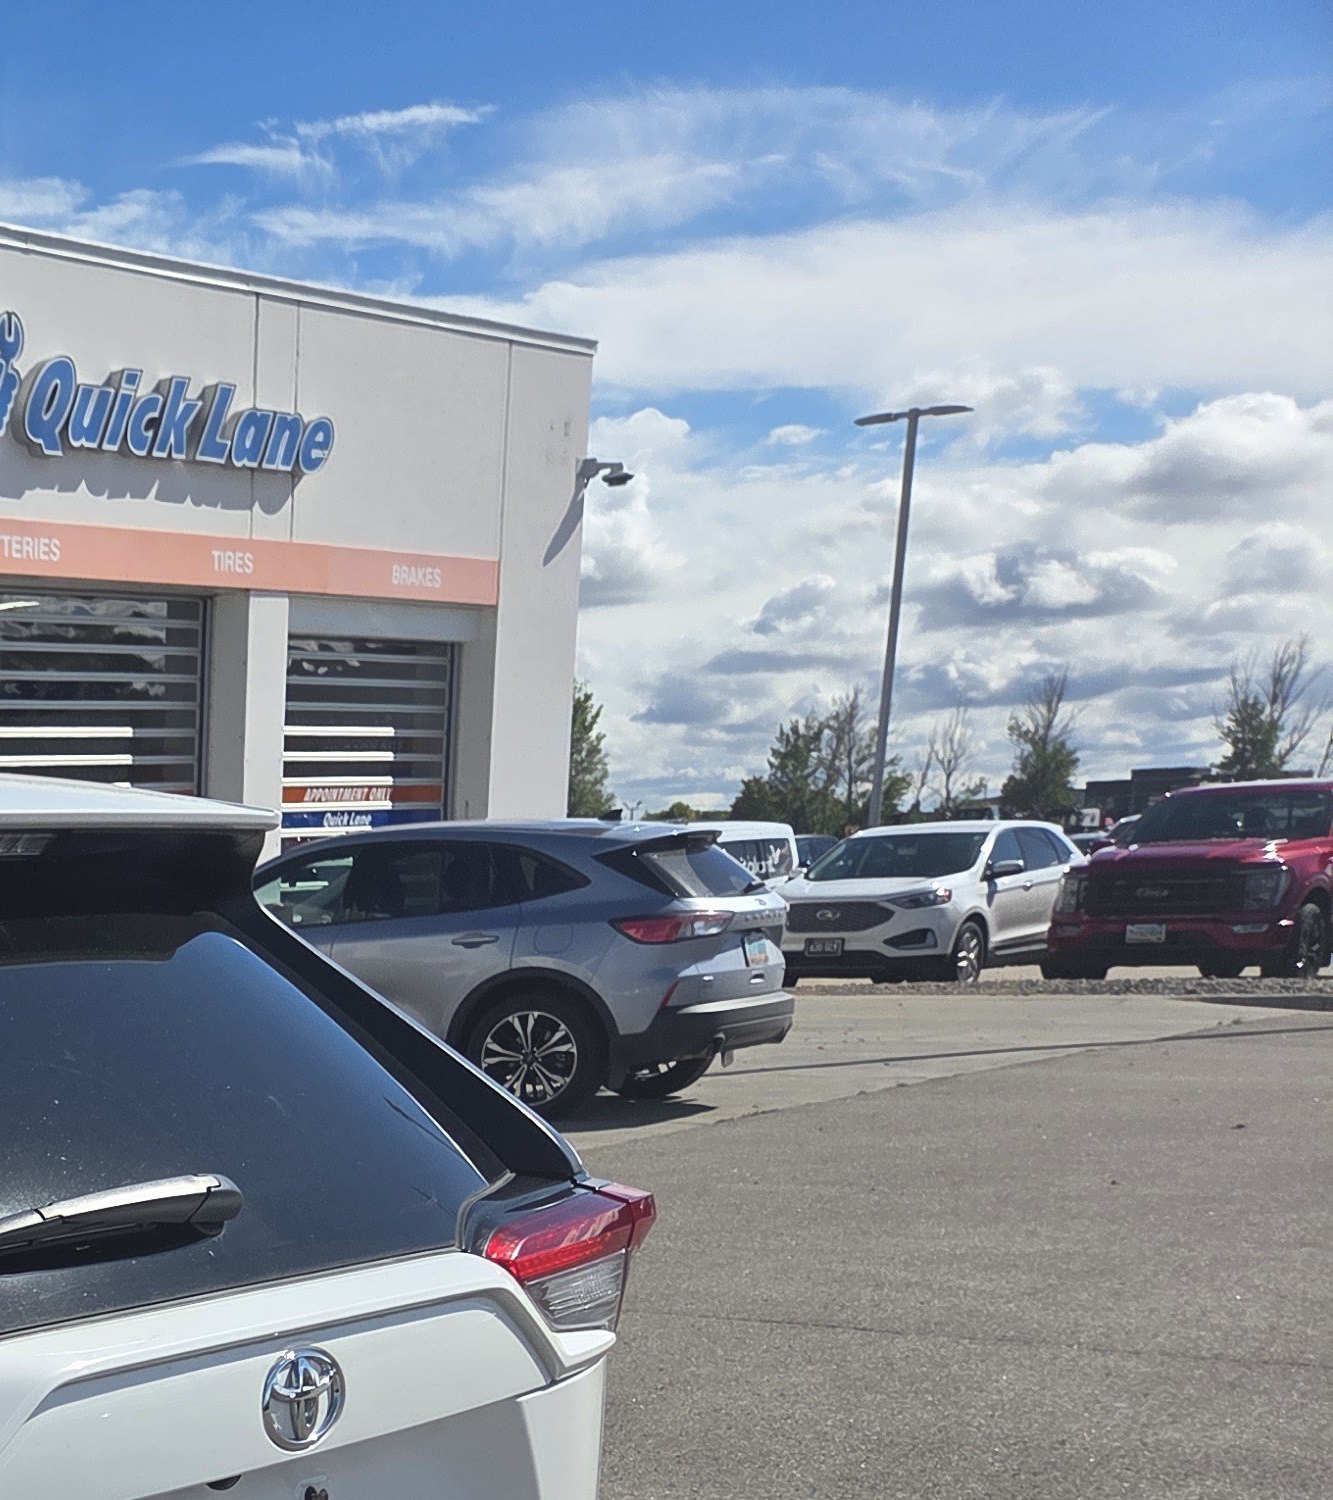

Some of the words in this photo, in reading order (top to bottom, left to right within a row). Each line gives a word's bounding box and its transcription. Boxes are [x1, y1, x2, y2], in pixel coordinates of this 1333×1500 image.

[22, 355, 203, 460] Quick
[195, 381, 334, 474] Lane
[211, 550, 255, 575] TIRES
[391, 564, 442, 589] BRAKES
[303, 787, 369, 802] APPOINTMENT
[369, 787, 394, 802] ONLY
[322, 811, 350, 828] Quick
[350, 812, 373, 826] Lane
